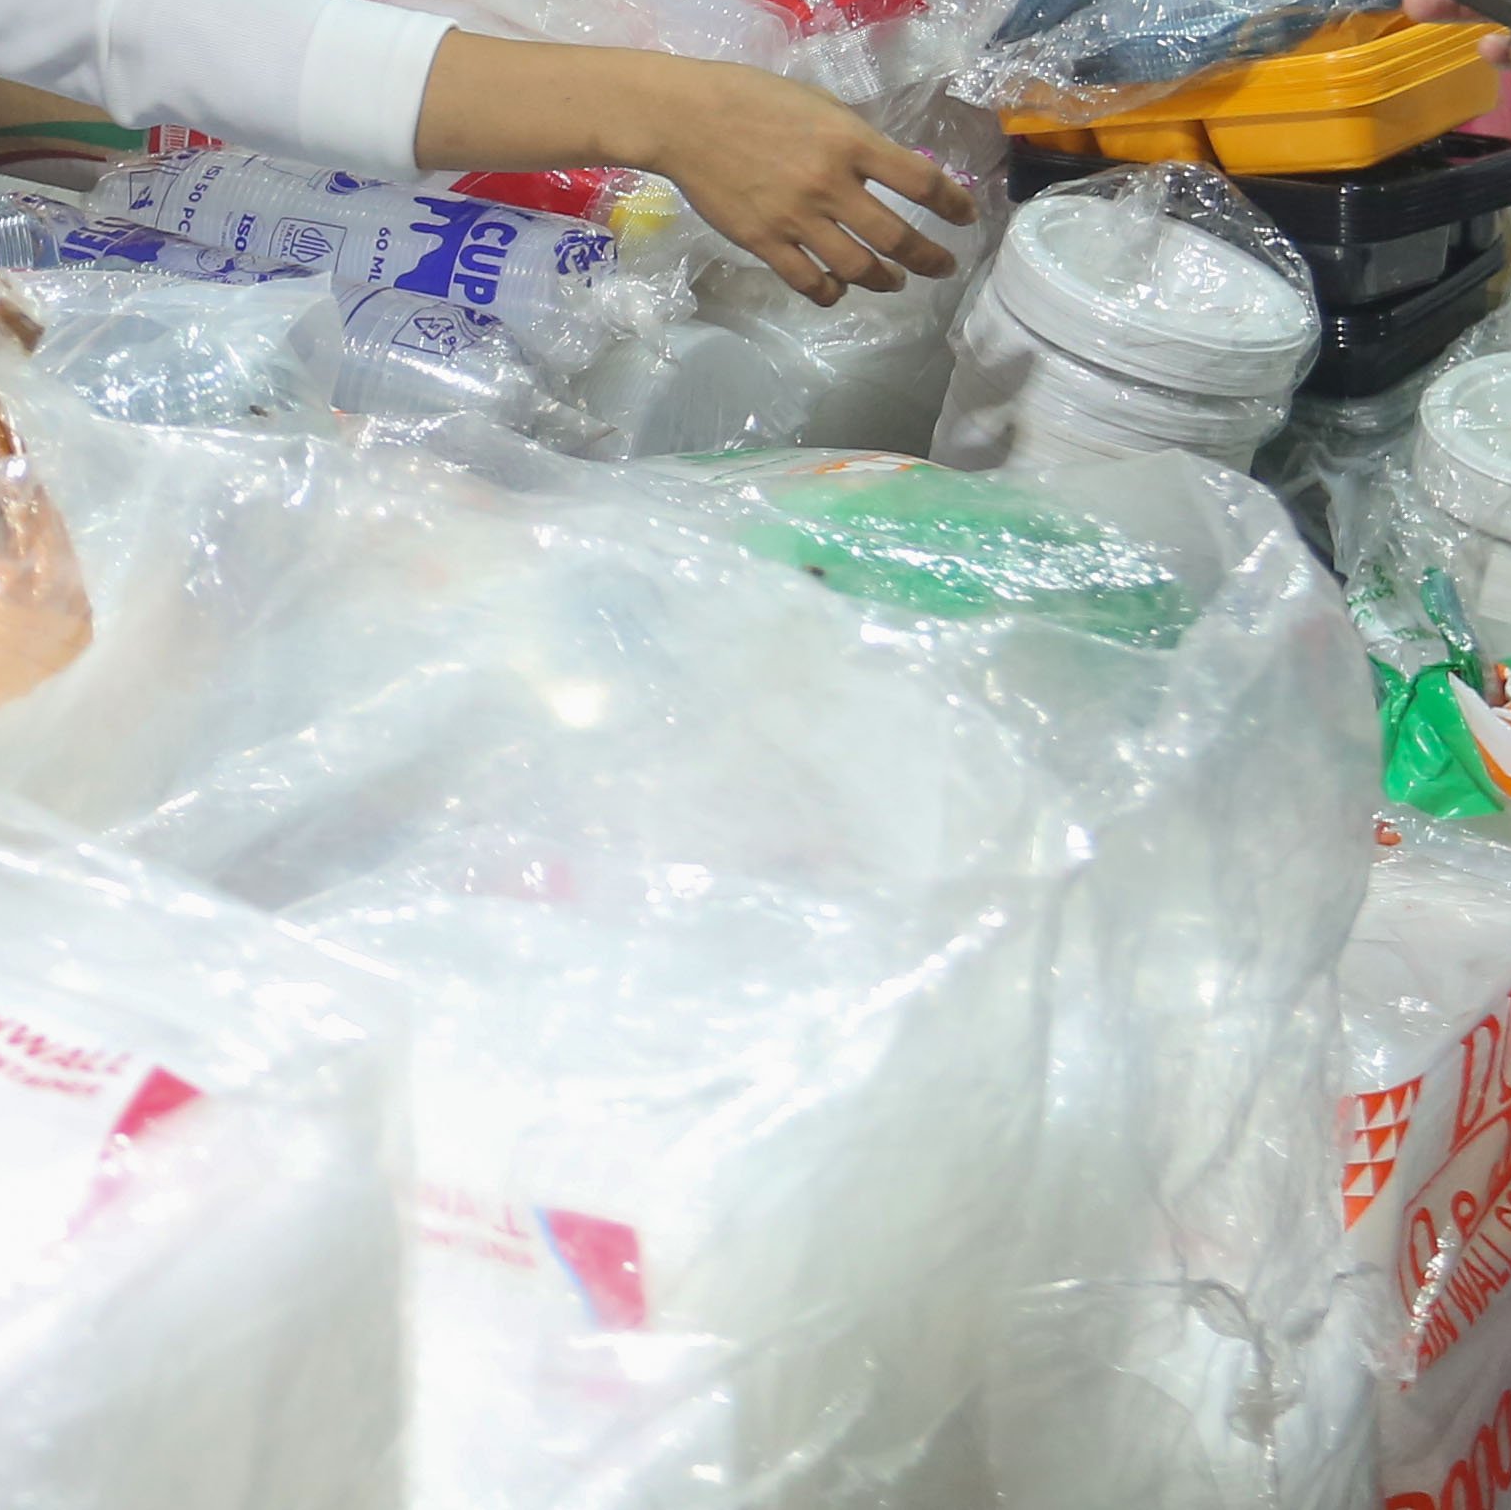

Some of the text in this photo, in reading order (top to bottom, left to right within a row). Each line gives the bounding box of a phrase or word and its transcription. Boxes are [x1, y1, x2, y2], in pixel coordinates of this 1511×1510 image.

[178, 206, 196, 234] PC
[234, 212, 257, 253] ISO
[454, 220, 519, 306] CUP
